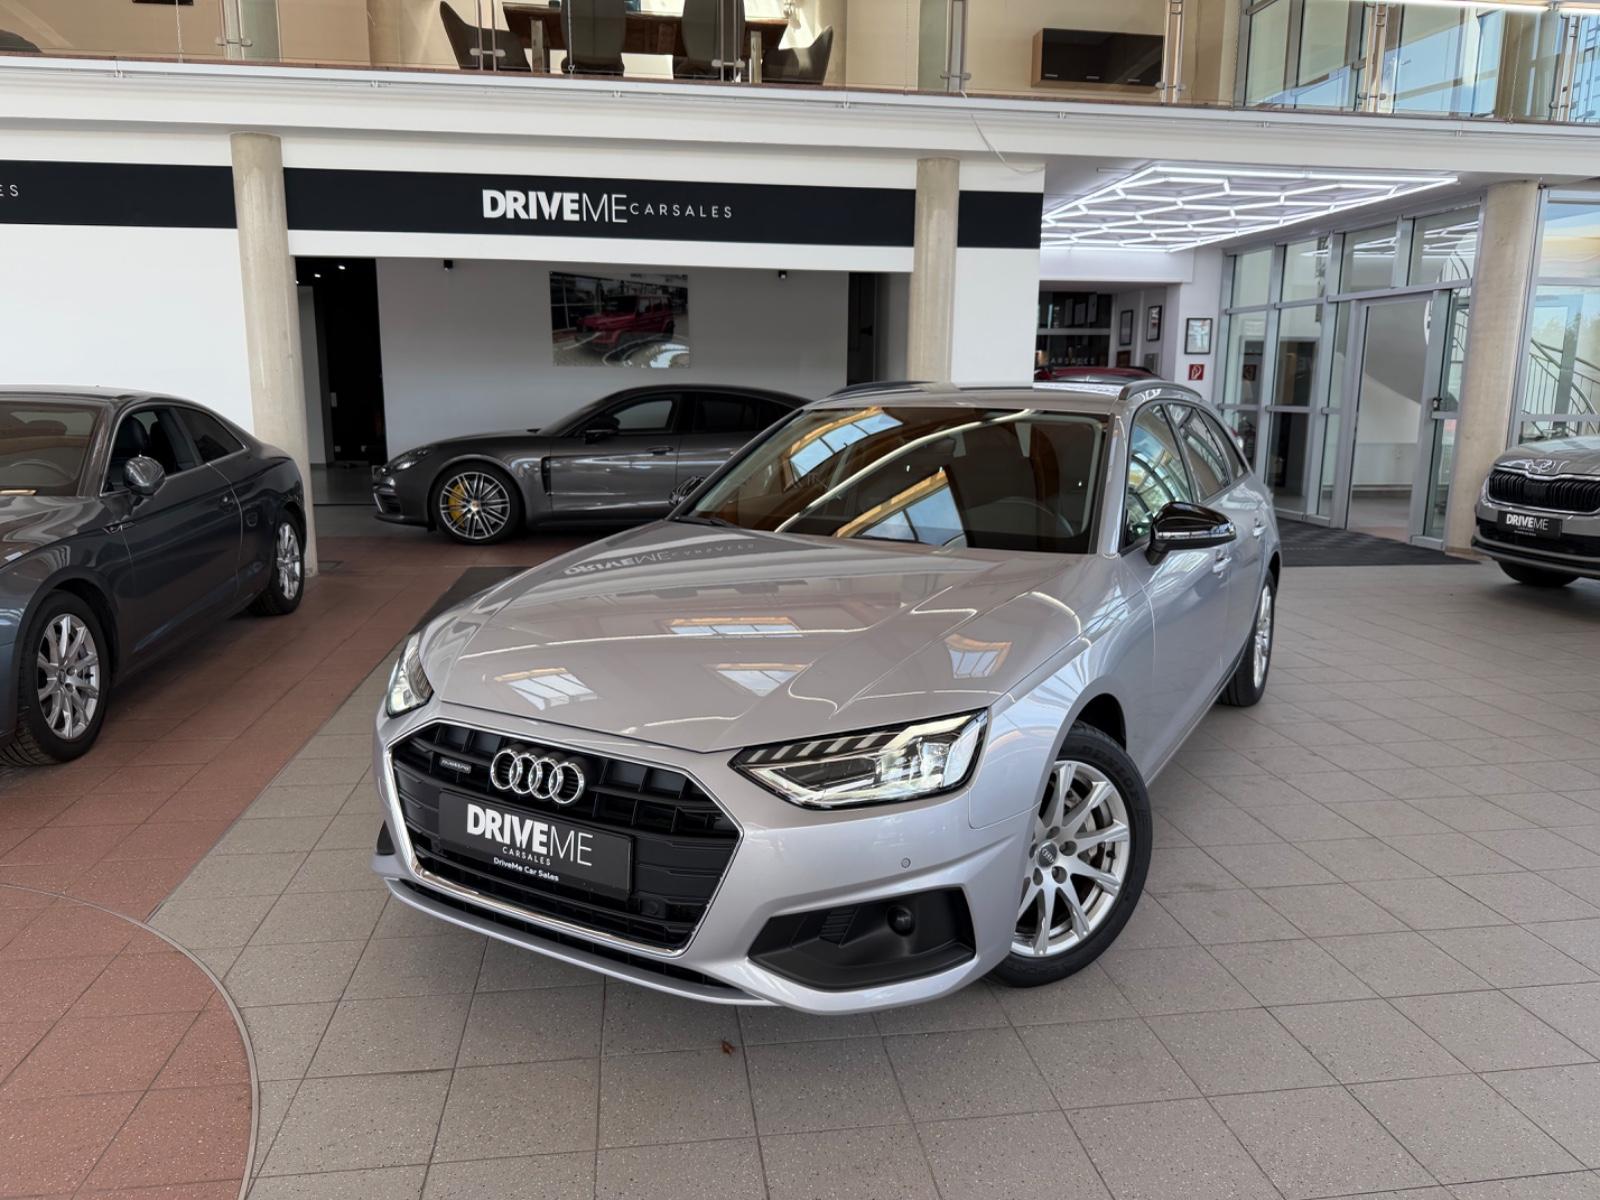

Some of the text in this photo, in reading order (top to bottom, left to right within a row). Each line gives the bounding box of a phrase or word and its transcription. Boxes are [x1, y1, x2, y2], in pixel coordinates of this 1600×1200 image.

[482, 189, 733, 224] DRIVEME CARSALES
[1506, 514, 1548, 530] DRIVEME
[466, 803, 594, 867] DRIVEME
[493, 856, 560, 882] DriveMe Car Sales
[502, 846, 551, 866] CARSALES
